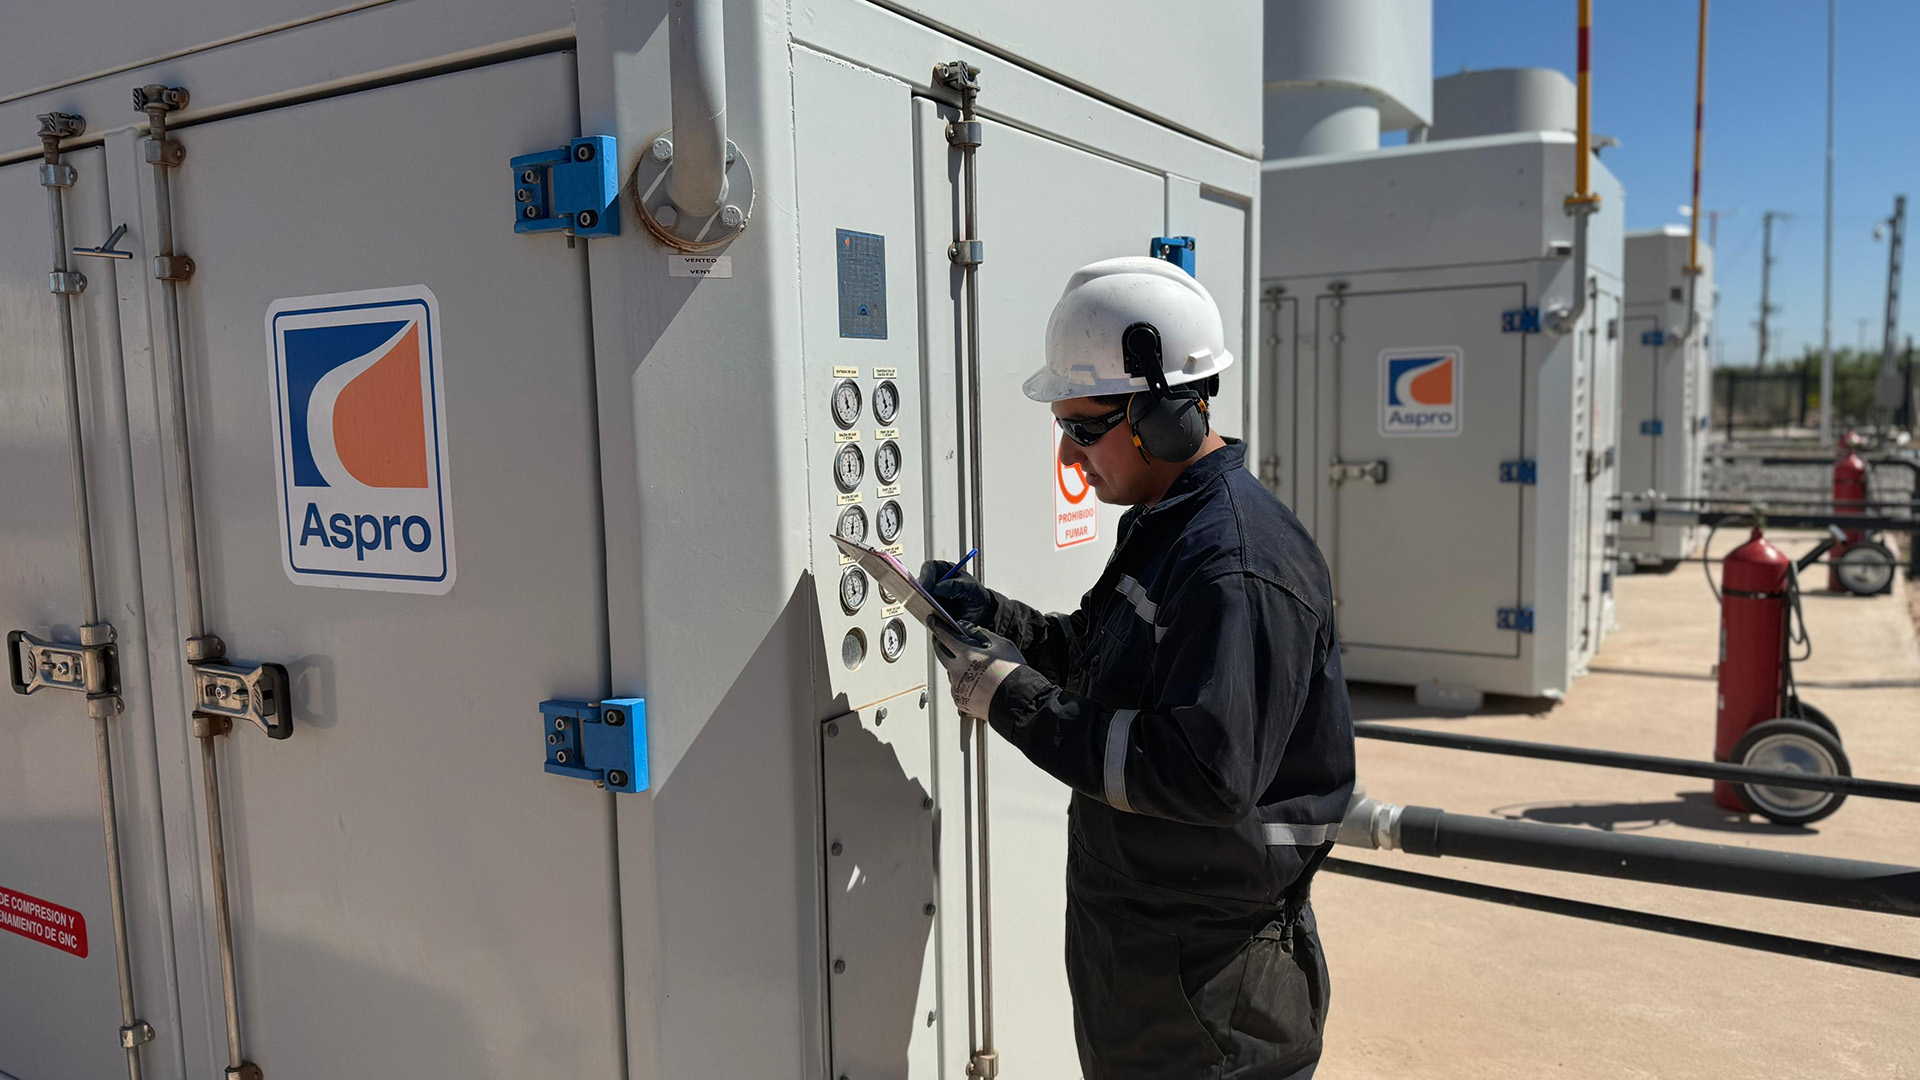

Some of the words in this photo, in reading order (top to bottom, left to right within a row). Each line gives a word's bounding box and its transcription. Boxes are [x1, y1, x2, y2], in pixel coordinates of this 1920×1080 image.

[1388, 410, 1452, 428] Aspro
[1058, 507, 1094, 524] PROHIBIDO
[299, 502, 432, 561] Aspro
[1065, 525, 1088, 540] FUMAR
[0, 892, 10, 907] DE
[11, 896, 67, 927] COMPRESION
[68, 915, 75, 929] Y
[45, 926, 57, 942] DE
[58, 931, 78, 949] GNC
